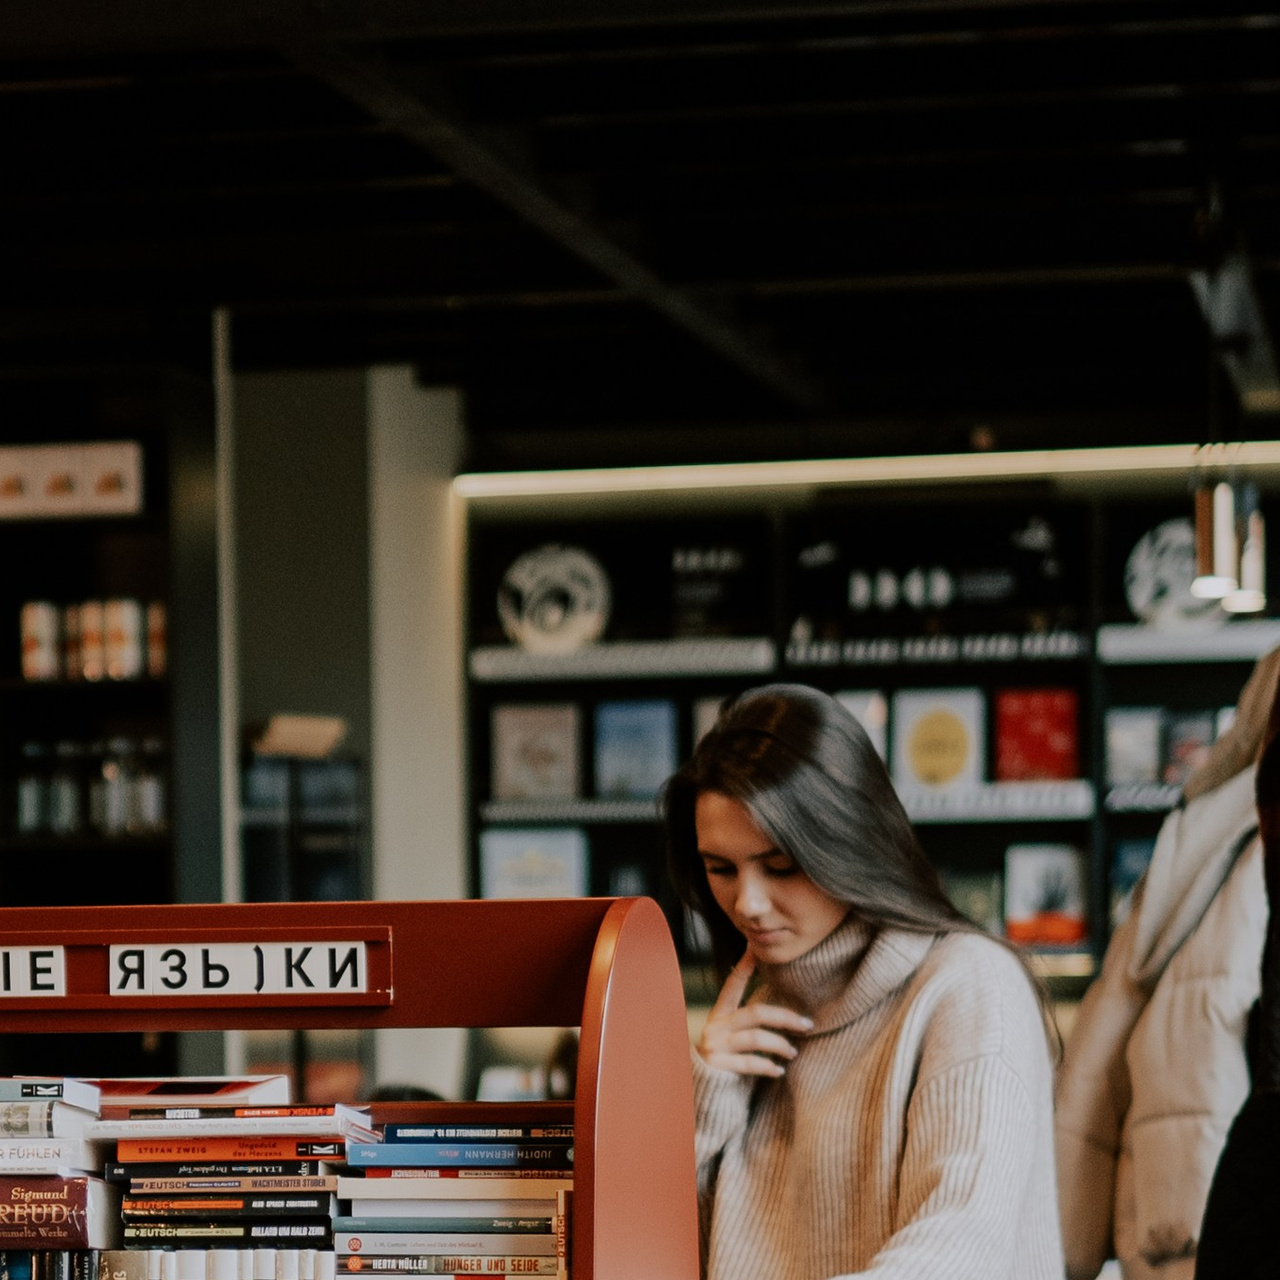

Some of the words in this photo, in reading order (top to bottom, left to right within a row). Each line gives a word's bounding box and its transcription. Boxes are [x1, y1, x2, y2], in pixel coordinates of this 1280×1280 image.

[238, 1141, 277, 1149] Ungeduld
[9, 1147, 61, 1159] FÜHLEN
[465, 1150, 514, 1158] HERMANN
[517, 1150, 551, 1158] JUDITH
[251, 1179, 301, 1188] WACHTMEISTER
[11, 1186, 68, 1202] Sigmund
[39, 1227, 68, 1238] Werke
[372, 1260, 396, 1269] HERTA
[398, 1258, 428, 1269] MÜLLER
[443, 1259, 482, 1272] HUNGER
[487, 1259, 505, 1272] UND
[510, 1259, 539, 1272] SEIDE
